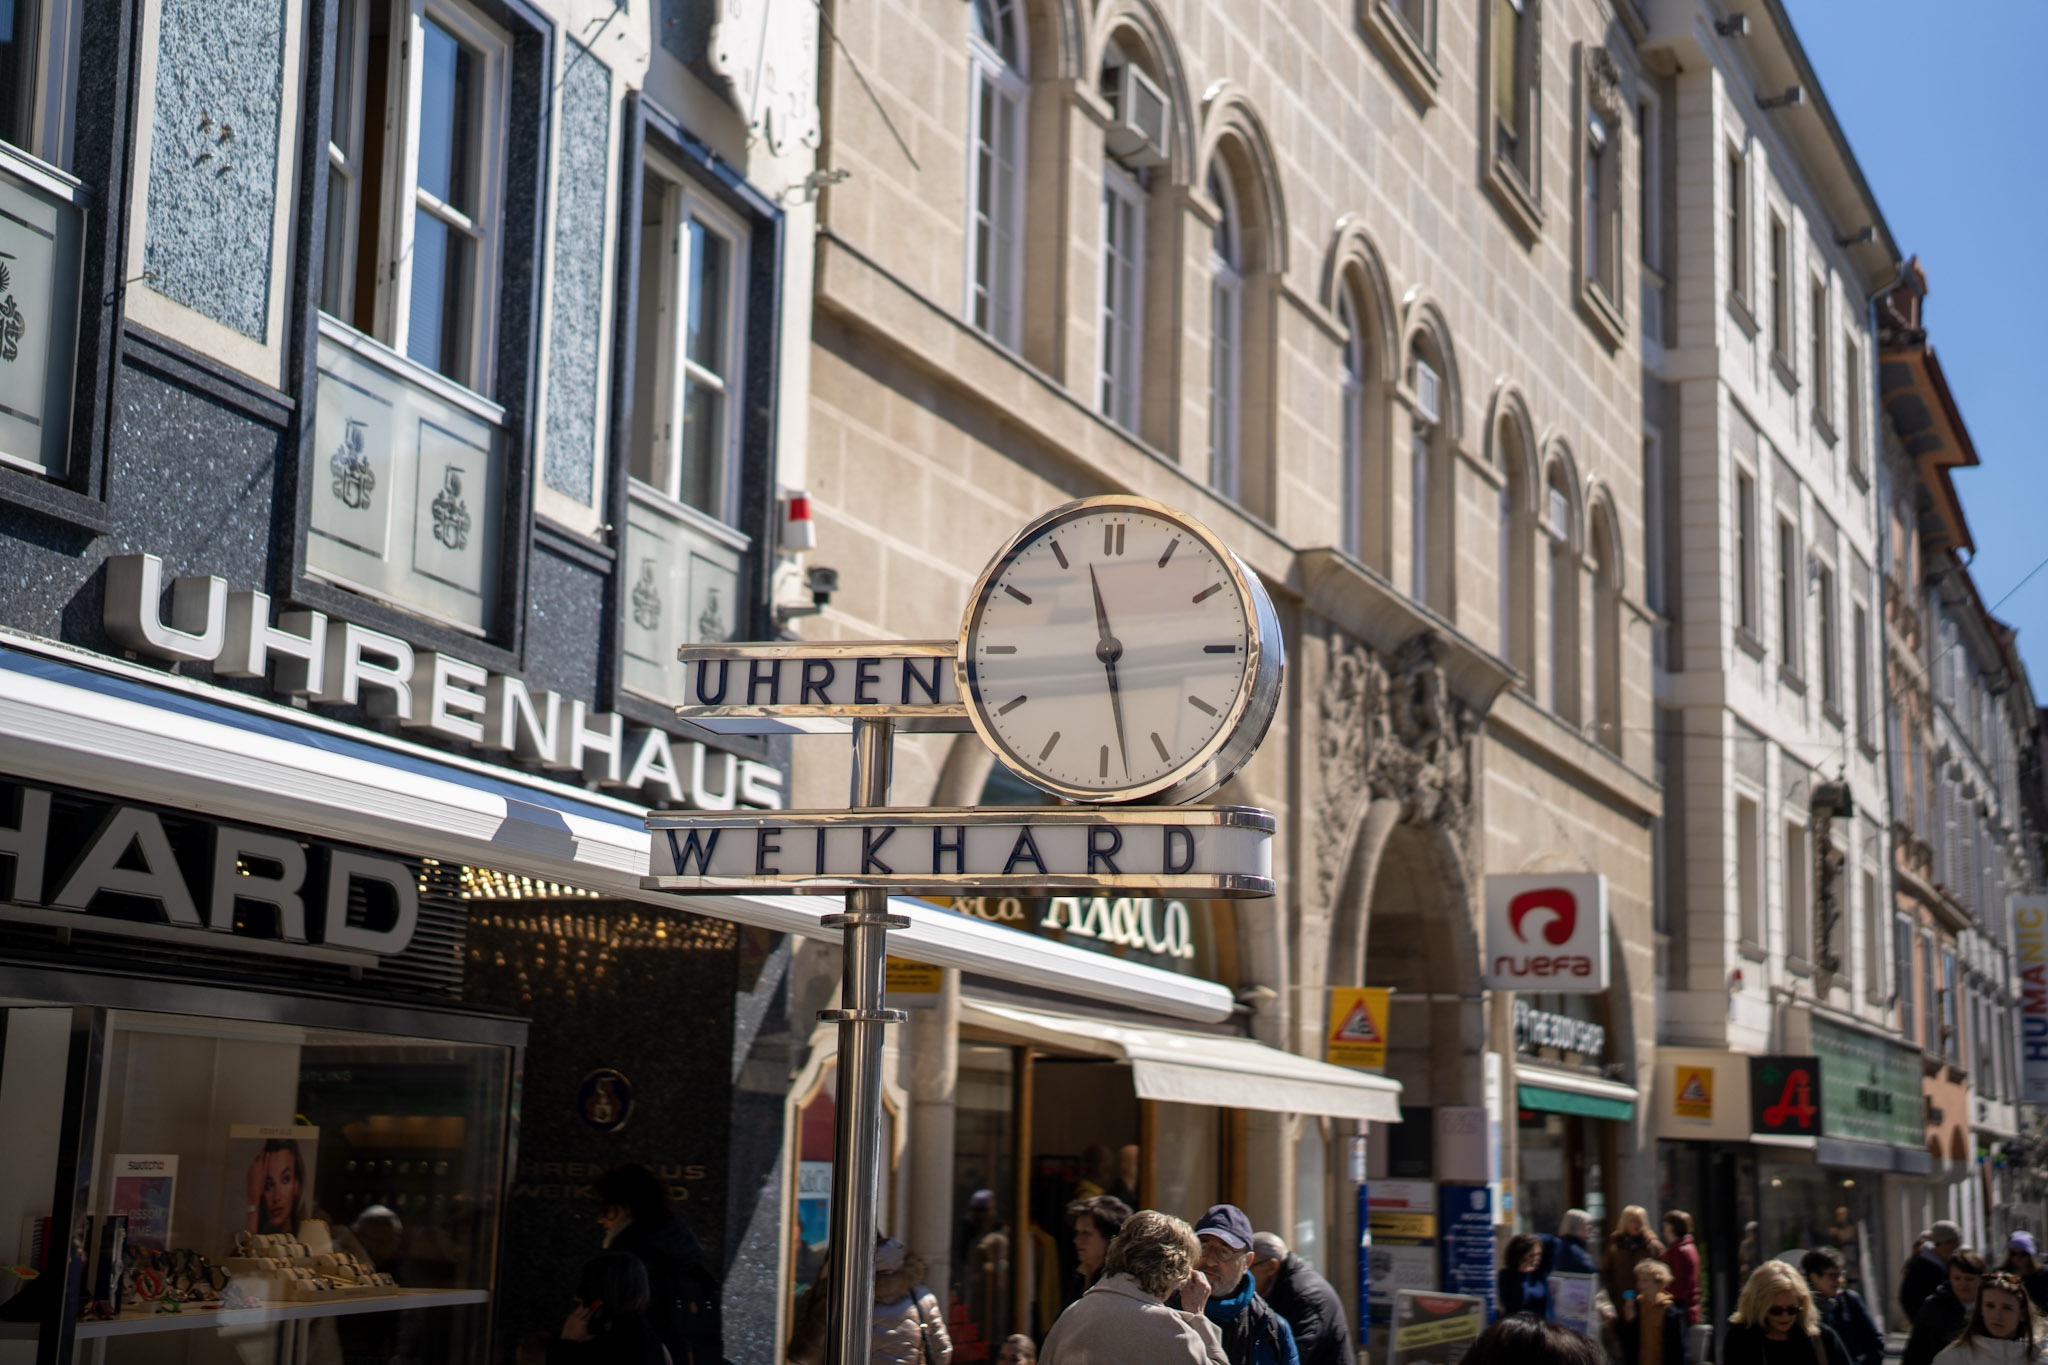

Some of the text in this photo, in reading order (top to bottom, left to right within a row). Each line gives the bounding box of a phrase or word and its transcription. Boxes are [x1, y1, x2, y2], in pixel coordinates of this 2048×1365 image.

[104, 553, 783, 810] UHRENHAUS
[694, 656, 942, 705] UHREN
[0, 786, 420, 956] HARD
[666, 825, 1196, 876] WEIKHARD
[1494, 954, 1593, 978] ruefa
[2016, 906, 2048, 1062] HUMANIC
